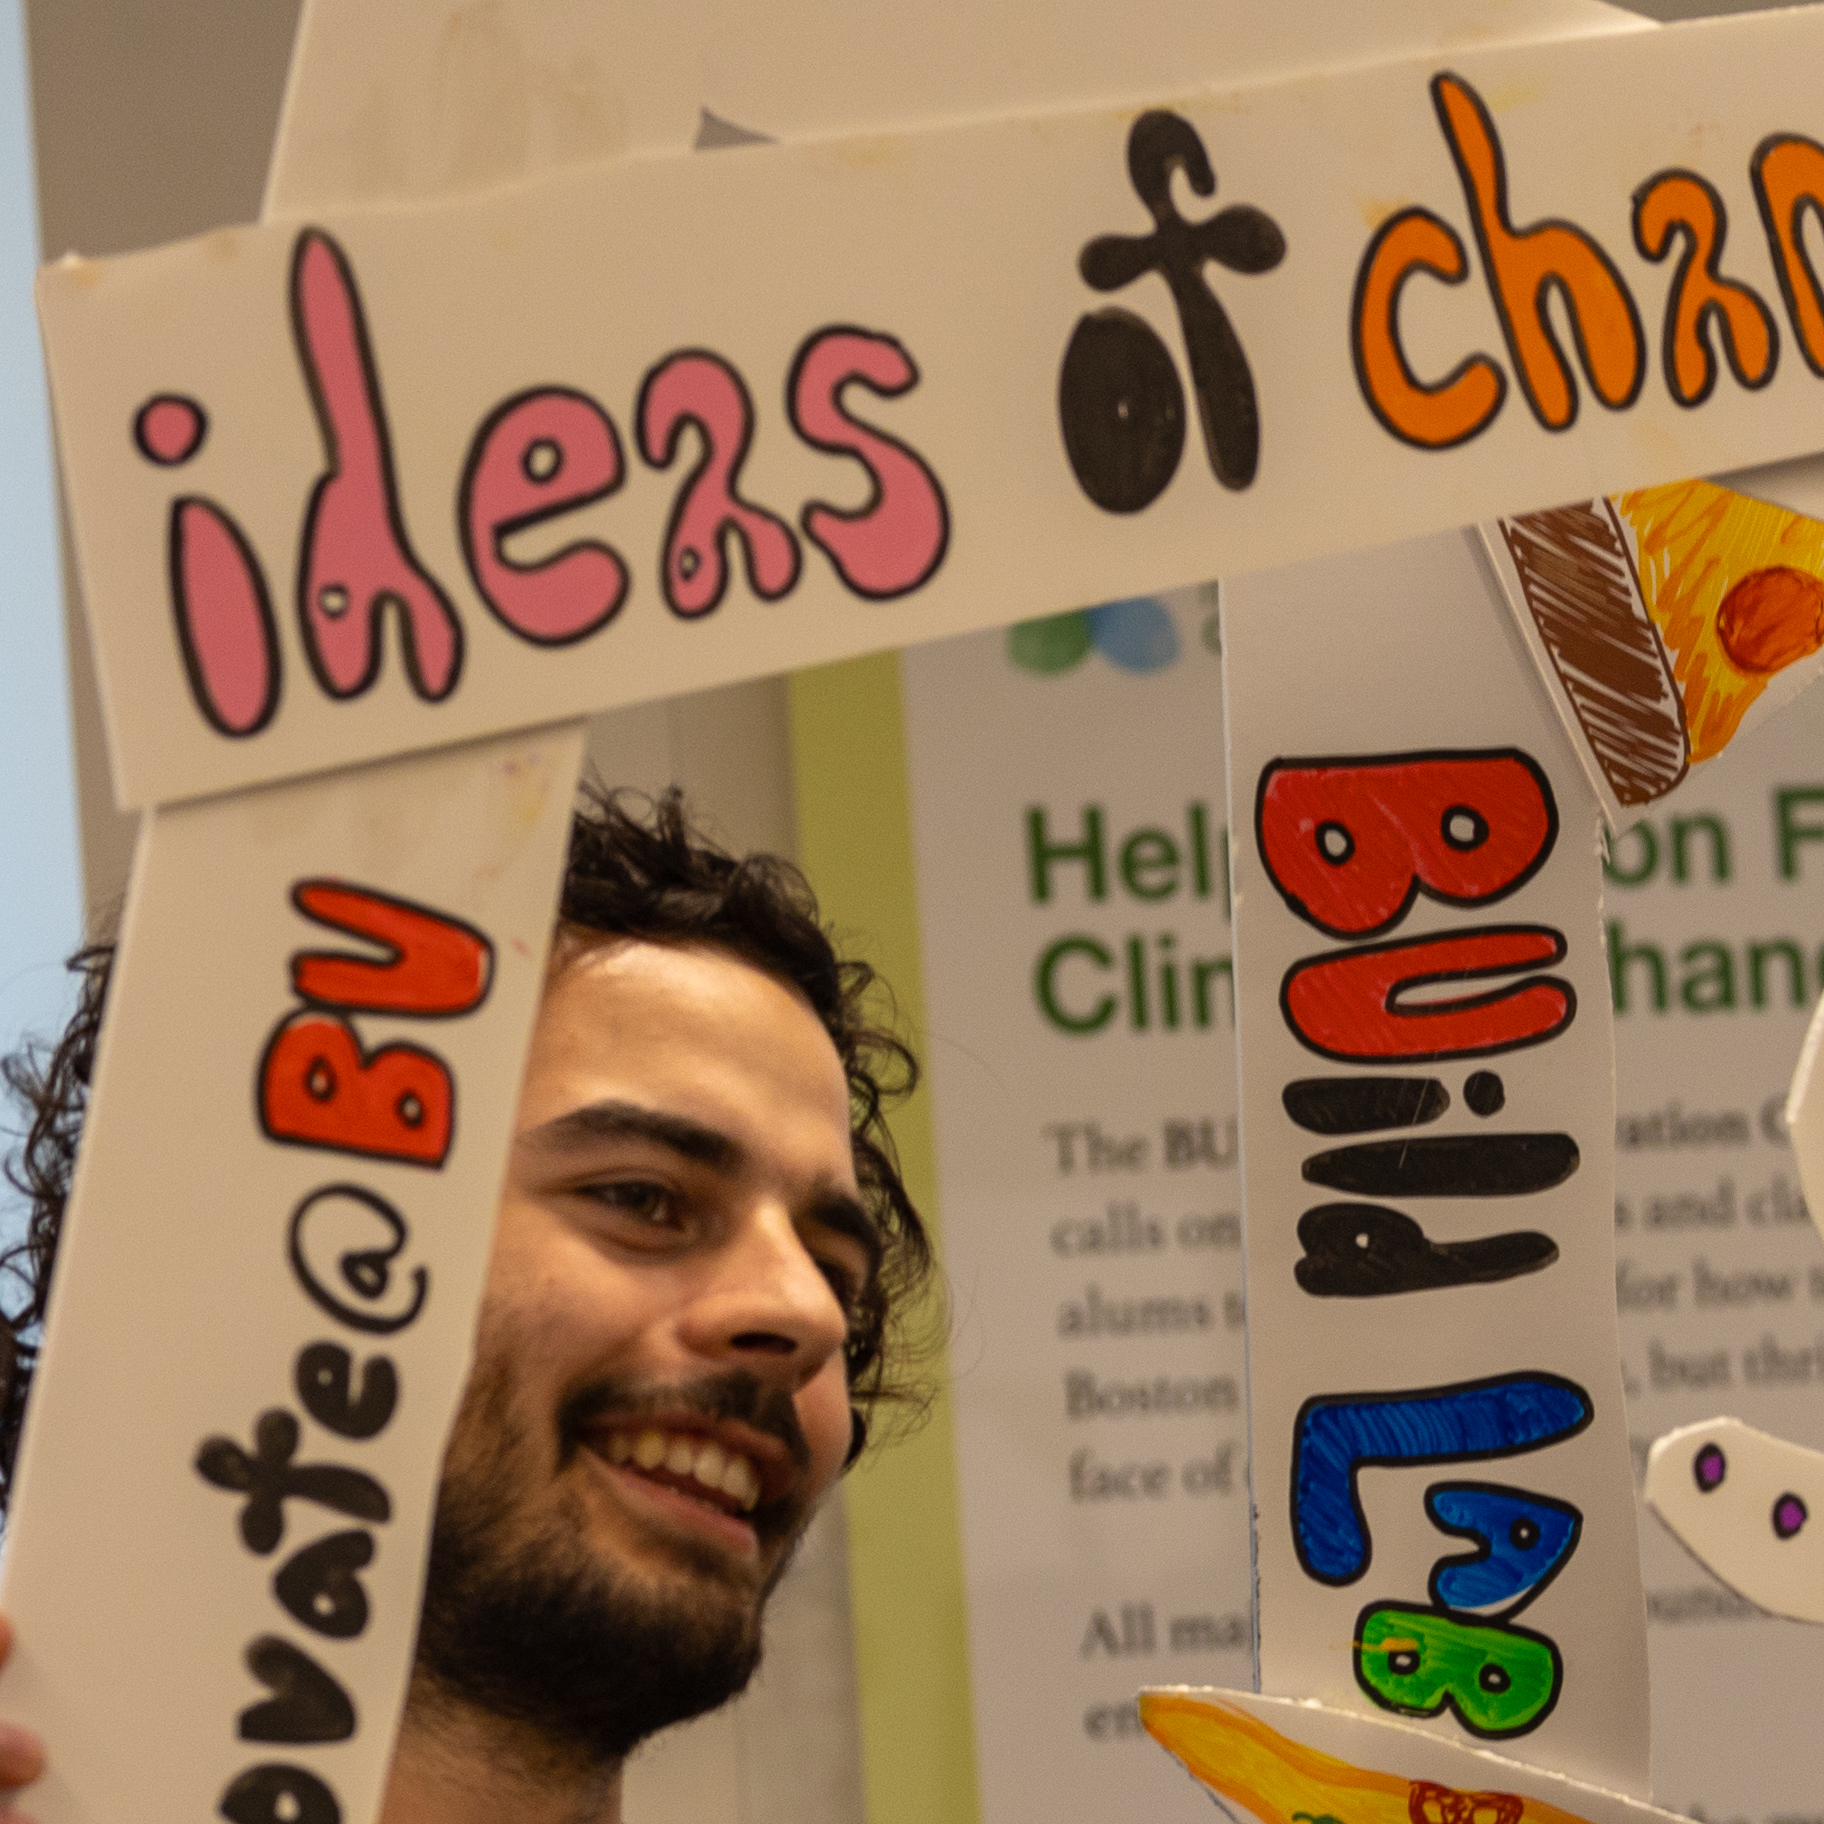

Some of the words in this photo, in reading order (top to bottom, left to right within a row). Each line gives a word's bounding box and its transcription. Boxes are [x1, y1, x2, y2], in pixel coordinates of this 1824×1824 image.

[134, 227, 949, 739] ideas
[1055, 110, 1286, 516] of
[1025, 801, 1232, 925] Hel
[1065, 1367, 1240, 1420] Boston
[1290, 1370, 1594, 1739] LAB
